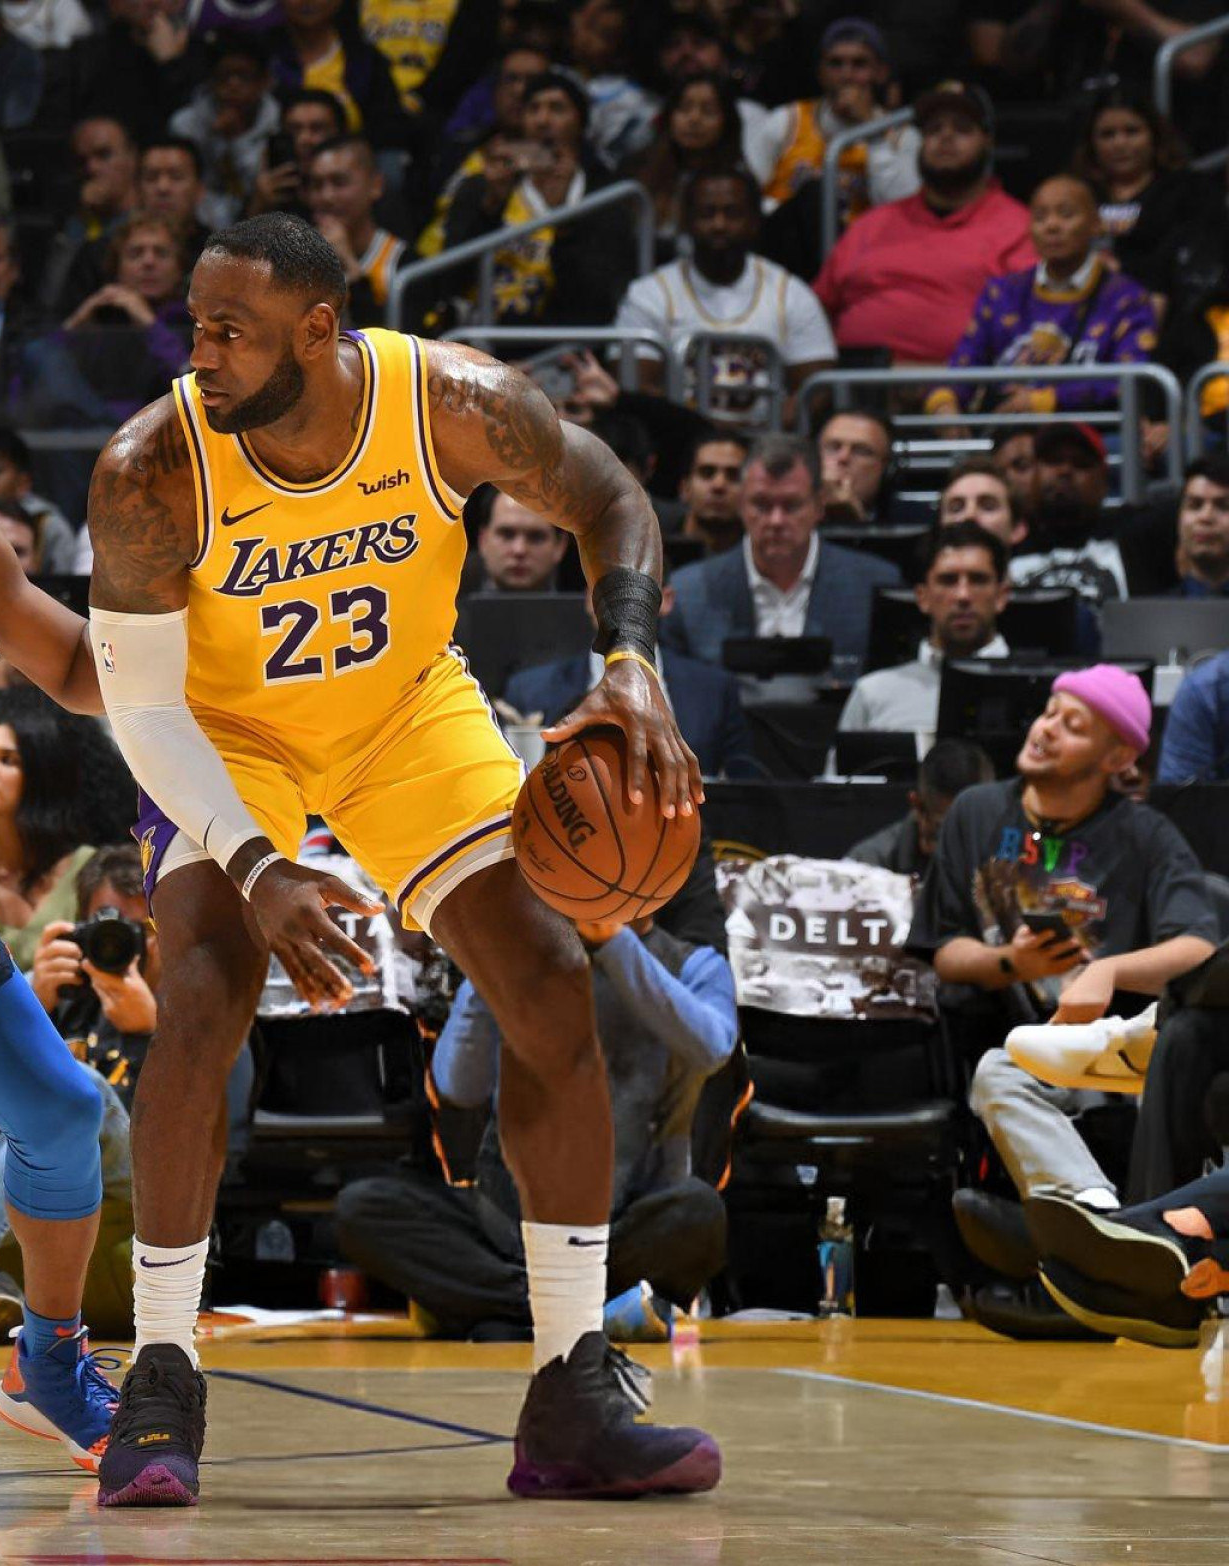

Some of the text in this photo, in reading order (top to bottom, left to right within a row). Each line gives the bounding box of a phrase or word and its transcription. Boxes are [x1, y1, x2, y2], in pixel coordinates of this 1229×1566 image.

[357, 469, 410, 496] wish
[213, 513, 420, 599] LAKERS
[261, 584, 391, 687] 23
